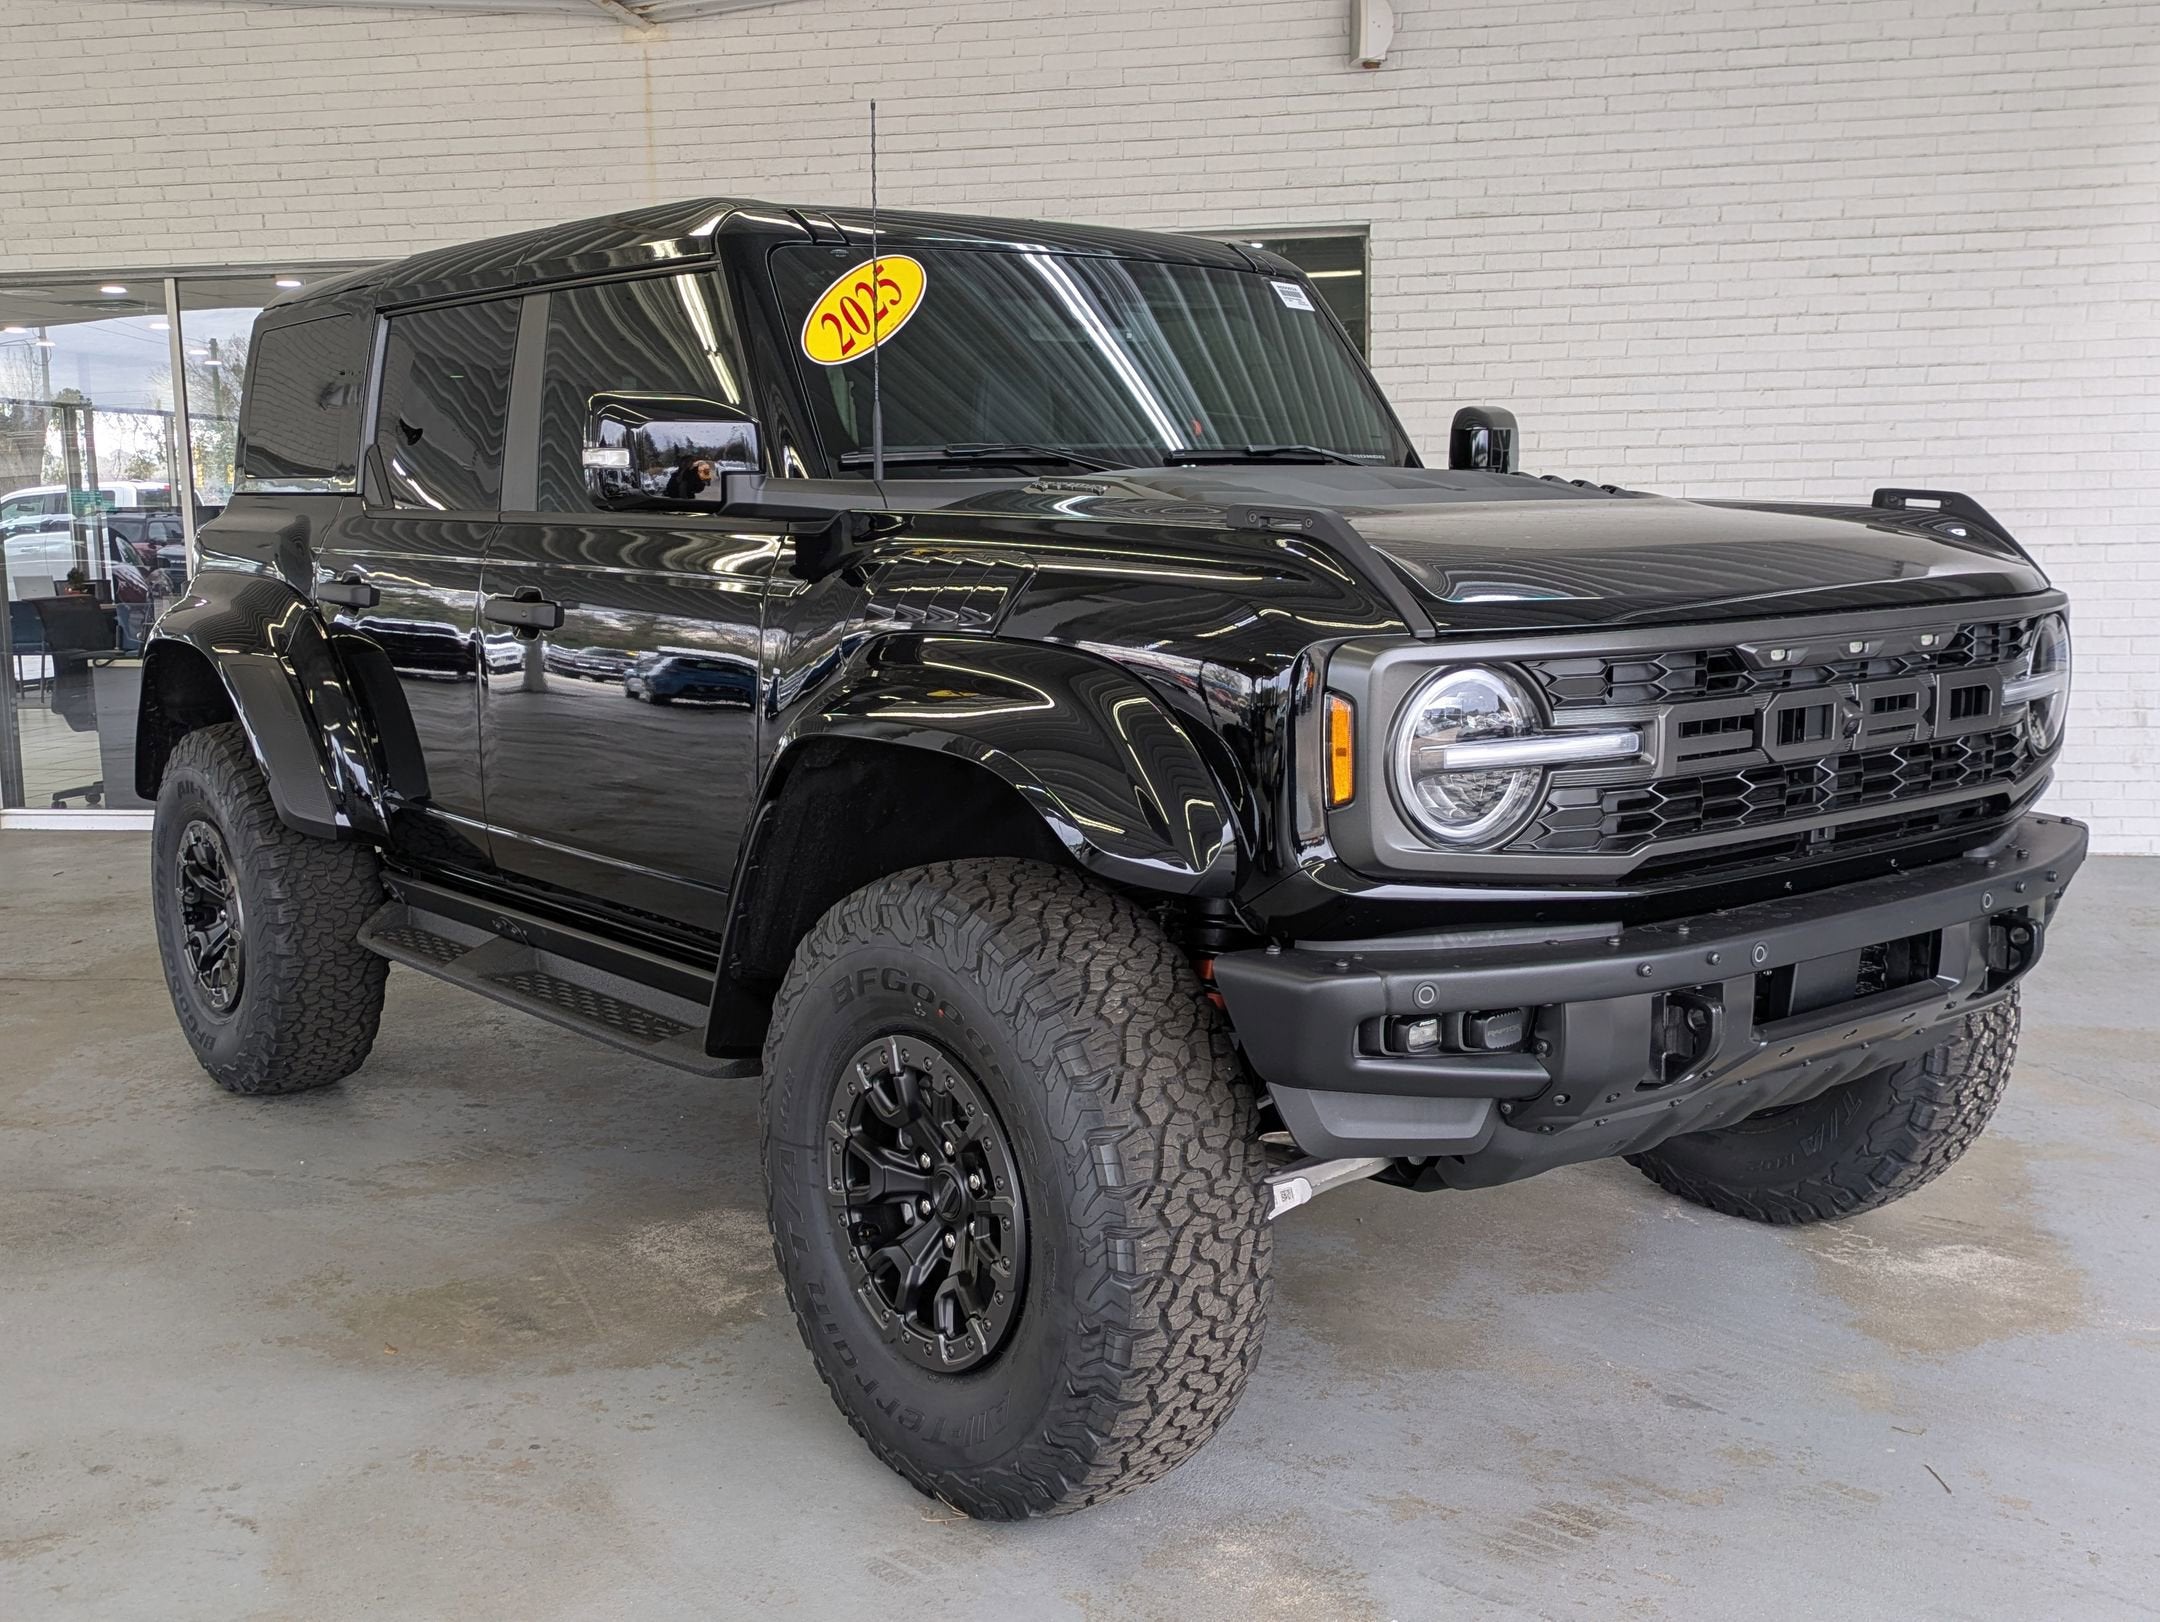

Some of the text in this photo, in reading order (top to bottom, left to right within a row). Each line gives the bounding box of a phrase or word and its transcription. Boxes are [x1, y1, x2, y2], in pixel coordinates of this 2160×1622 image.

[820, 264, 902, 356] 2025
[1658, 664, 2003, 779] FORD
[1487, 1023, 1521, 1037] RAPTOR
